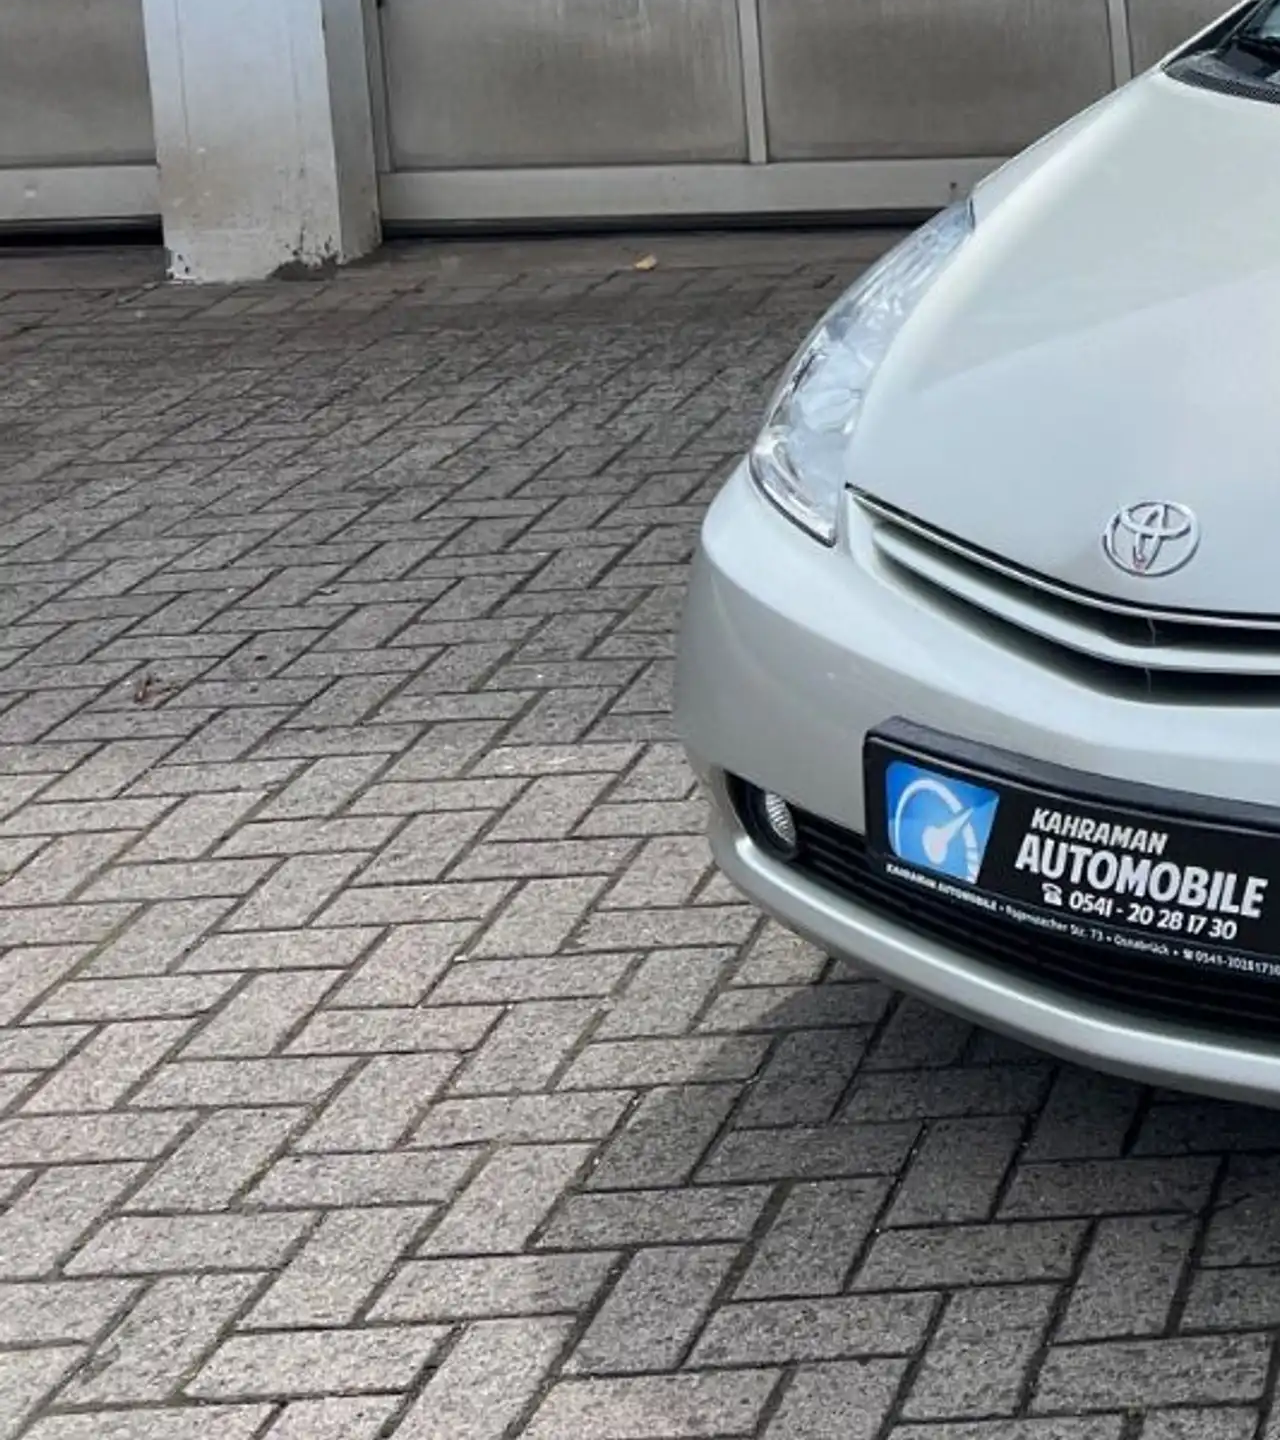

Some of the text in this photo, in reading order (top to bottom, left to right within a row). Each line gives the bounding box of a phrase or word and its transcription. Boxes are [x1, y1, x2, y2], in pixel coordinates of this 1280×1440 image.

[1031, 807, 1169, 856] KAHRAMAN
[1015, 834, 1269, 918] AUTOMOBILE
[1069, 889, 1113, 918] 0541
[1126, 904, 1154, 926] 20
[1157, 909, 1182, 931] 28
[1188, 914, 1208, 934] 17
[1208, 918, 1238, 941] 30
